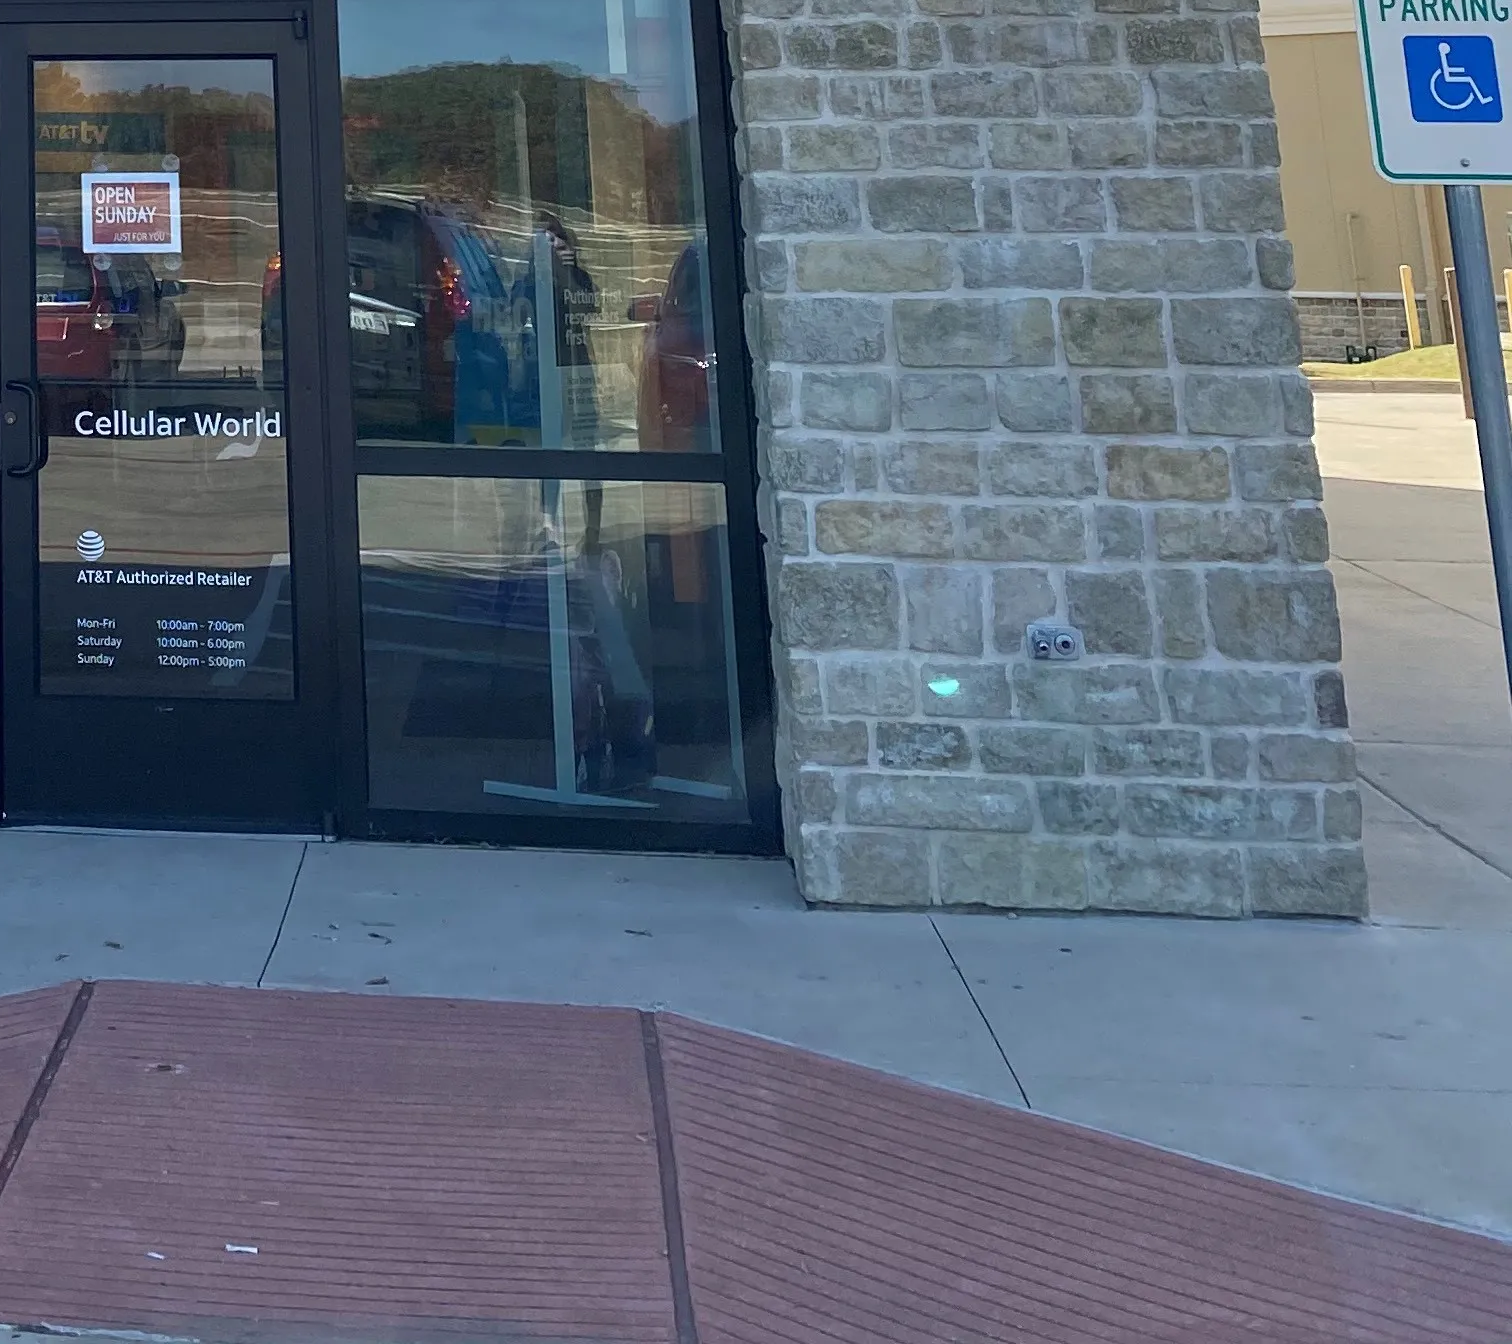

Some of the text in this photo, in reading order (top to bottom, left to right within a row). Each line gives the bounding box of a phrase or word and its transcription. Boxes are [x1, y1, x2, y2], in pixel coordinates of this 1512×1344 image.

[39, 124, 79, 140] AT&T
[94, 186, 136, 204] OPEN
[94, 206, 157, 224] SUNDAY
[113, 231, 166, 243] JUST FOR YOU
[36, 293, 57, 303] T&T
[563, 288, 600, 308] Putting
[565, 329, 588, 346] first
[74, 409, 282, 438] Cellular World
[76, 569, 253, 586] AT&T Authorized Retailer
[76, 617, 116, 630] Mon-Fri
[156, 619, 199, 631] 10:00am
[207, 620, 245, 634] 7:00pm
[76, 635, 123, 649] Saturday
[156, 637, 199, 649] 10:00am
[76, 652, 115, 667] Sunday
[157, 654, 200, 668] 12:00pm
[208, 656, 246, 670] 5:00pm
